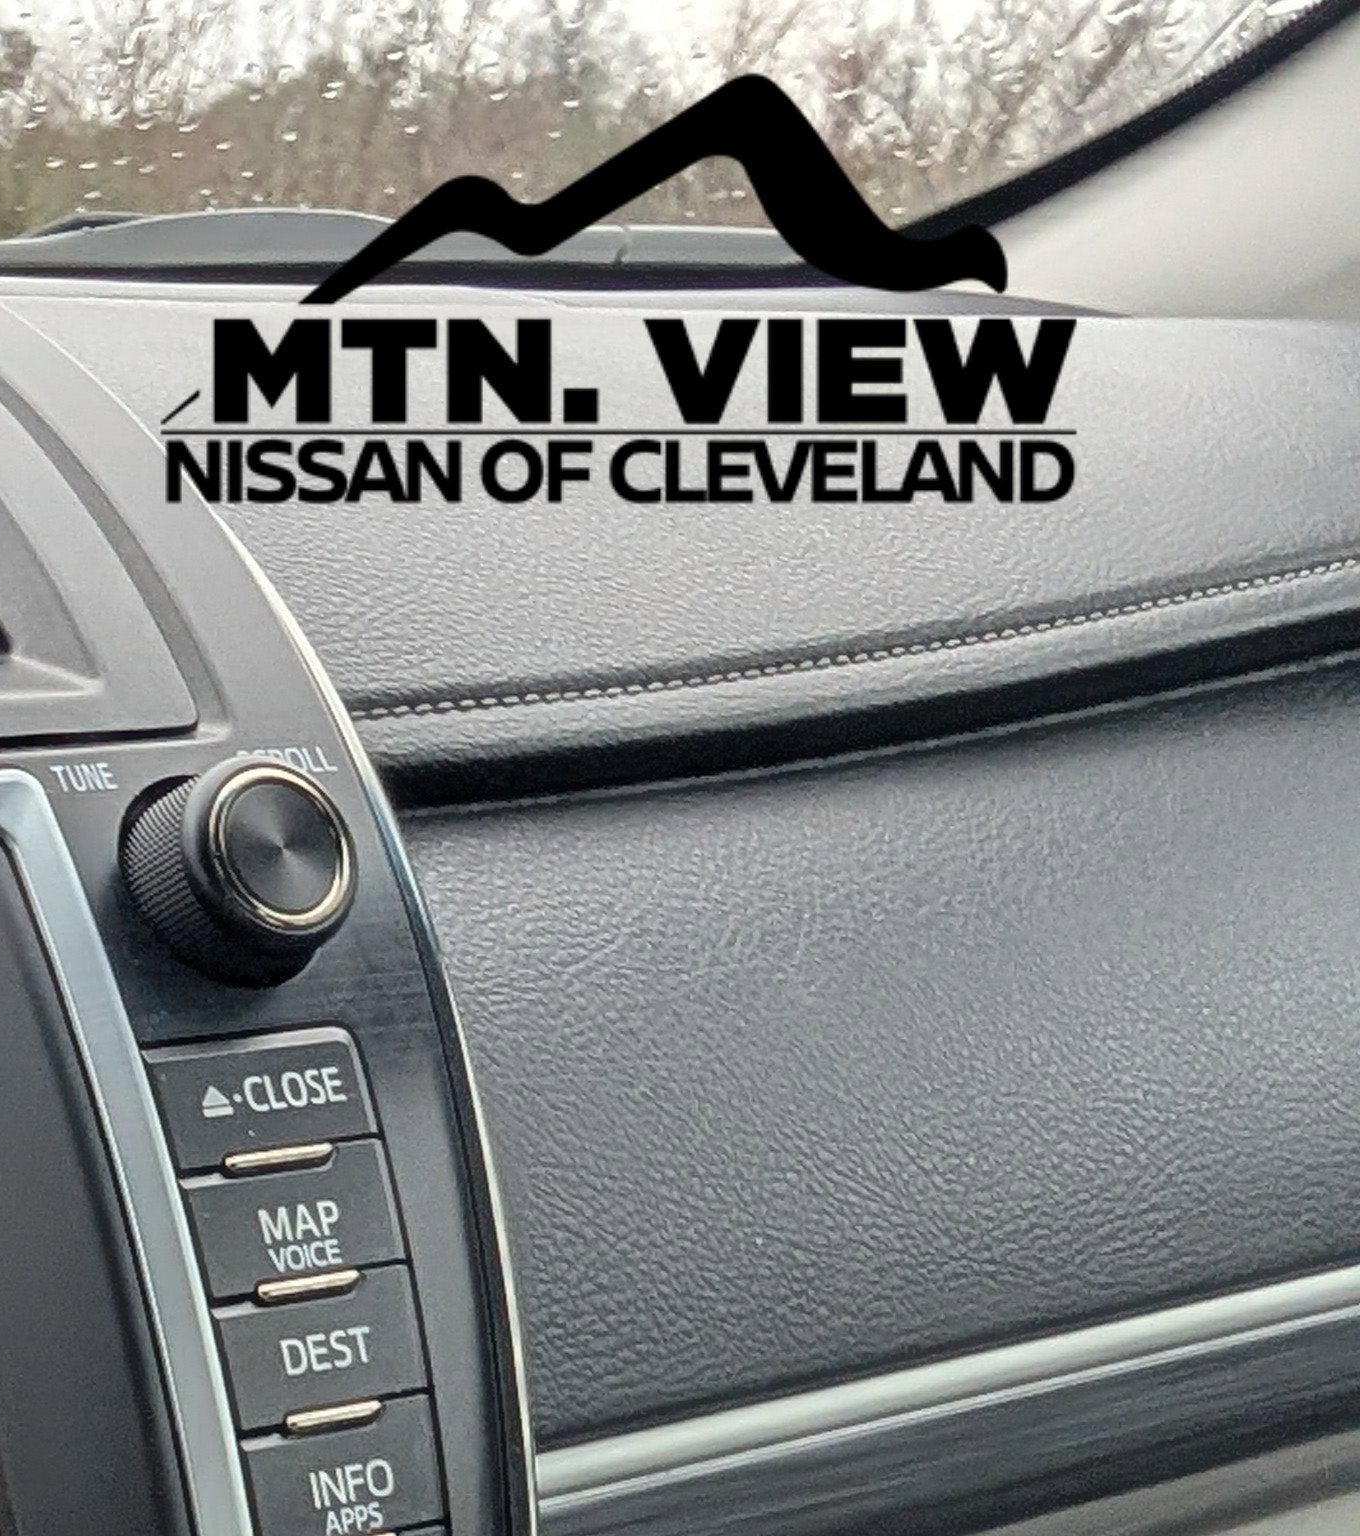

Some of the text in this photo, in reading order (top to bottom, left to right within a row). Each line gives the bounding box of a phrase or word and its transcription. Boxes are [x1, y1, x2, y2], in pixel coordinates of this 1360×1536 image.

[50, 762, 118, 793] TUNE
[243, 1066, 347, 1113] CLOSE
[257, 1200, 340, 1245] MAP
[267, 1239, 343, 1273] VOICE
[280, 1326, 371, 1376] DEST
[309, 1458, 395, 1510] INFO
[326, 1501, 384, 1536] APPS
